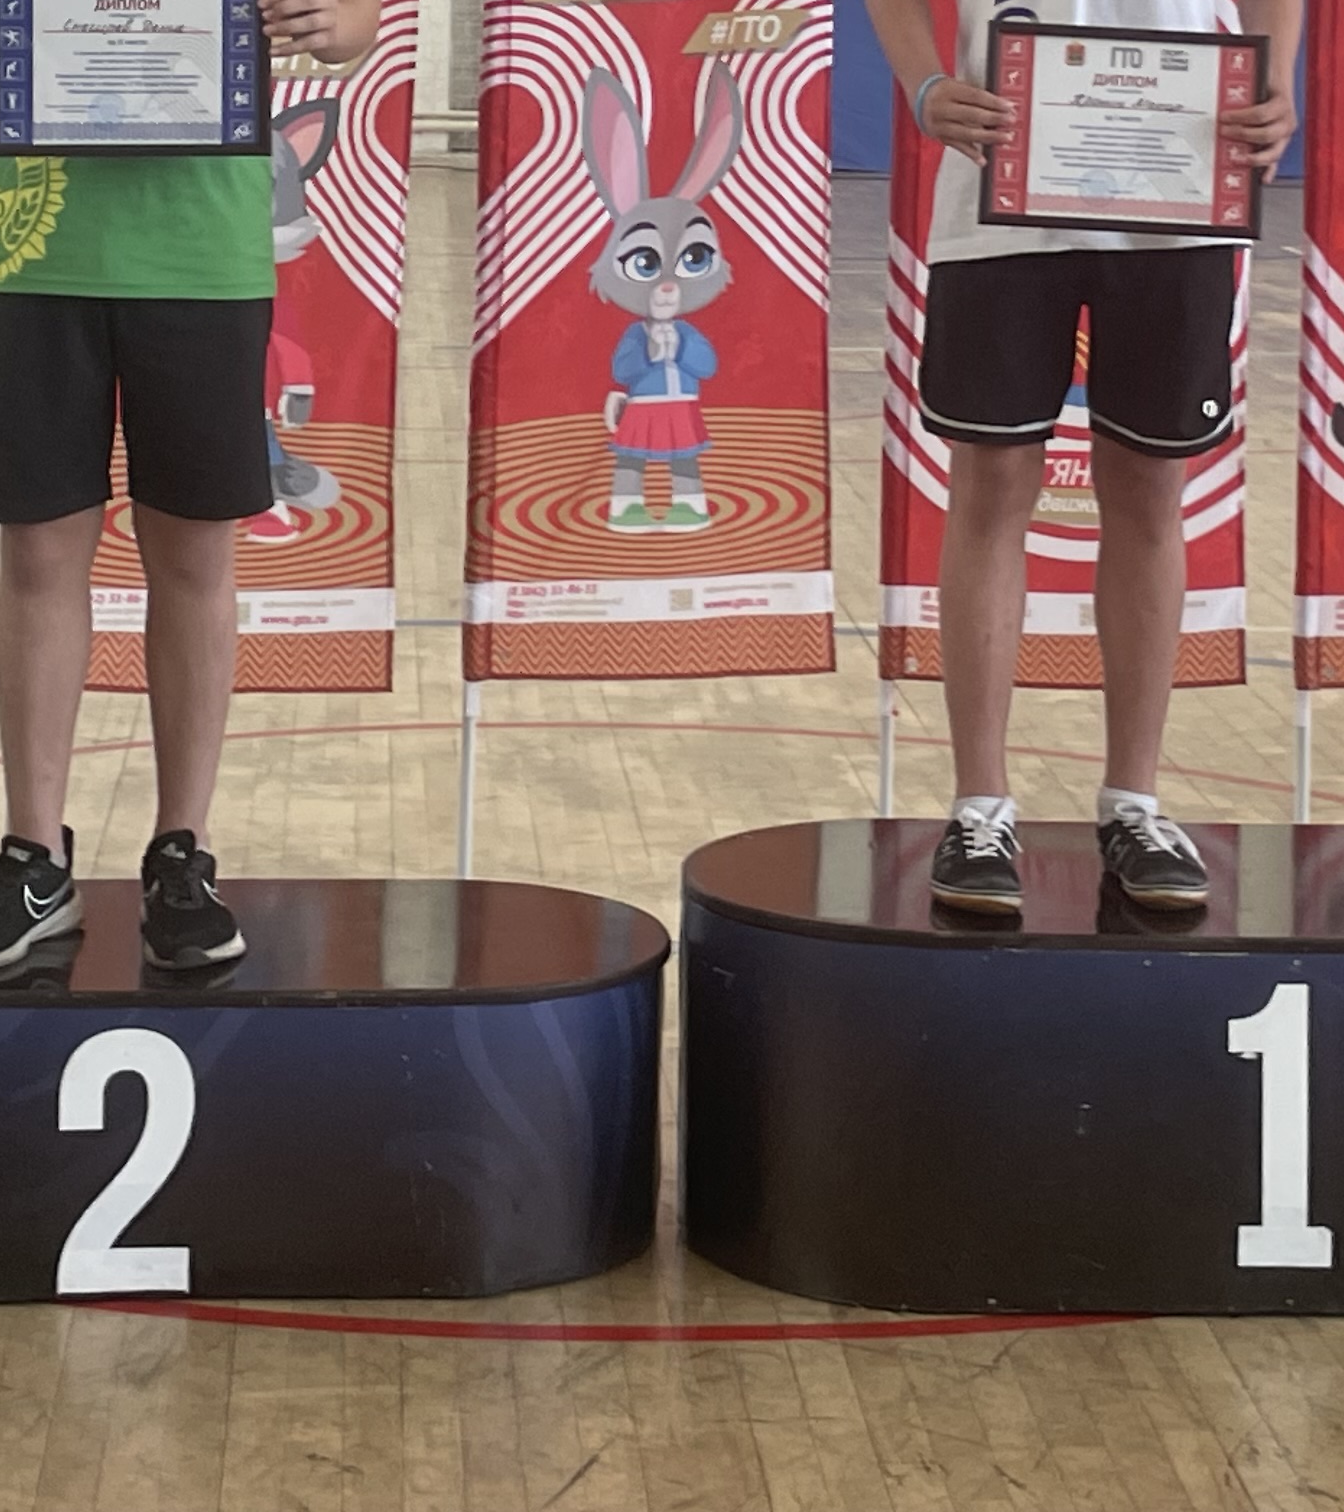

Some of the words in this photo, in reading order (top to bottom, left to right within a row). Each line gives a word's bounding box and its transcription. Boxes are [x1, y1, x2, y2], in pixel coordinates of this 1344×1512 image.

[710, 14, 783, 45] #ГТО
[1092, 73, 1159, 88] ДИПЛОМ
[57, 1027, 197, 1295] 2
[1228, 982, 1334, 1268] 1
